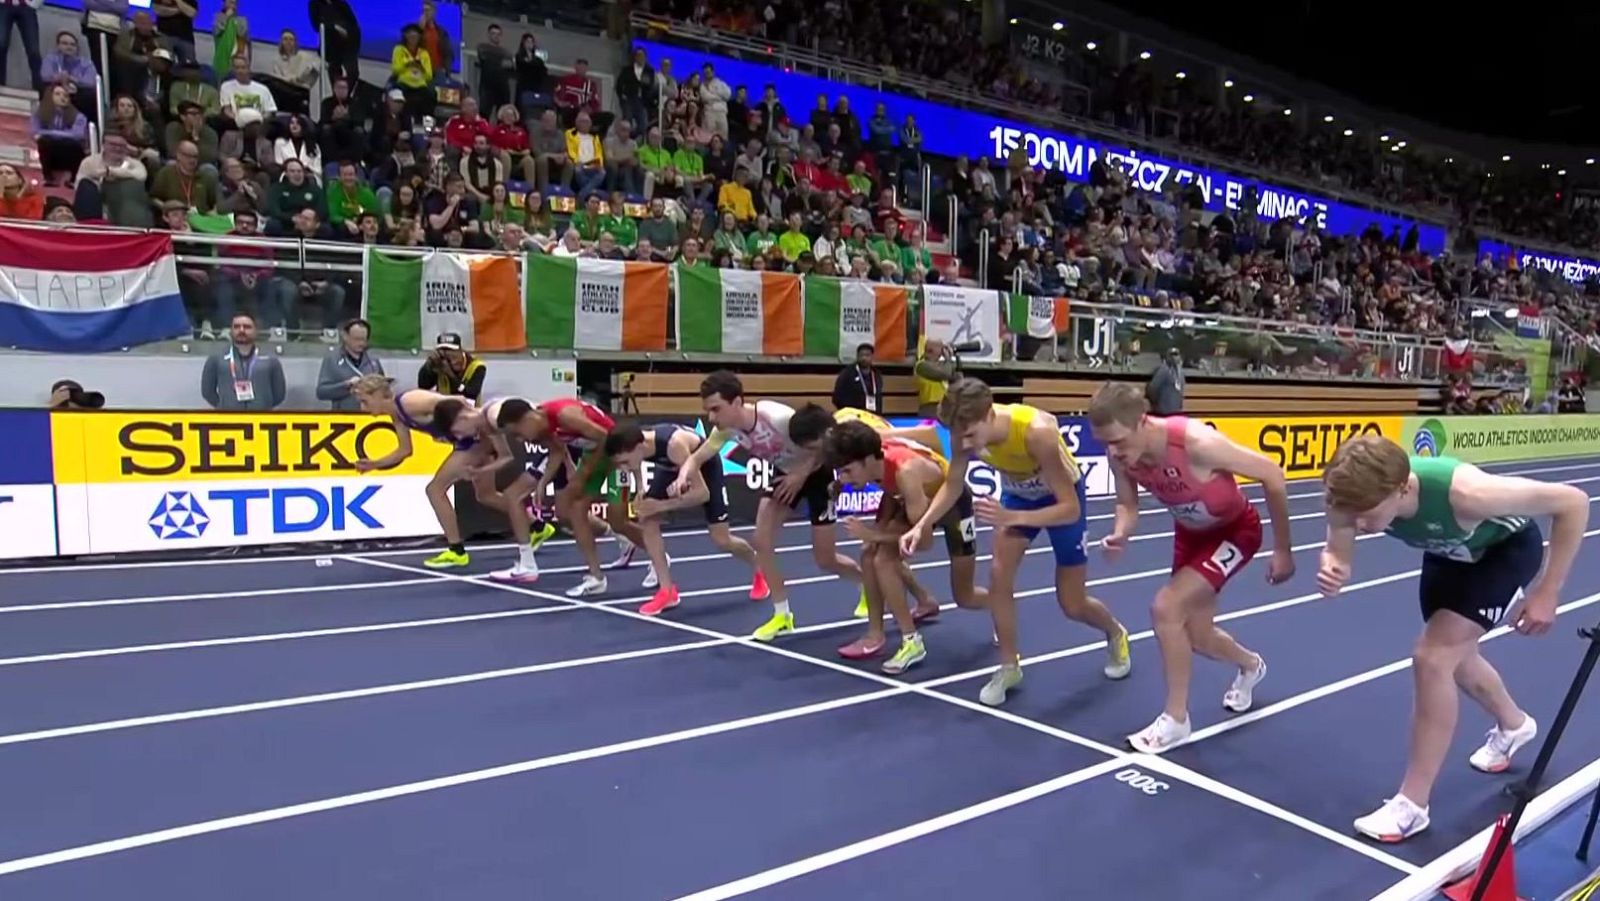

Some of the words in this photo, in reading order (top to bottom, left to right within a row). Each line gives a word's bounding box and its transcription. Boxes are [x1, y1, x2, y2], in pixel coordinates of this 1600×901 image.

[1044, 40, 1065, 61] K2
[989, 125, 1083, 176] 1500M
[426, 281, 466, 291] IRISH
[582, 282, 619, 292] IRISH
[427, 305, 468, 313] CLUB
[582, 305, 619, 314] CLUB
[1083, 318, 1111, 356] J1
[1398, 346, 1413, 371] J1
[118, 421, 404, 475] SEIKO
[1453, 432, 1485, 449] WORLD
[1486, 429, 1528, 447] ATHLETICS
[1530, 428, 1558, 445] INDOOR
[620, 471, 627, 483] 8
[208, 485, 385, 536] TDK
[965, 522, 974, 538] 4
[1221, 548, 1235, 568] 2
